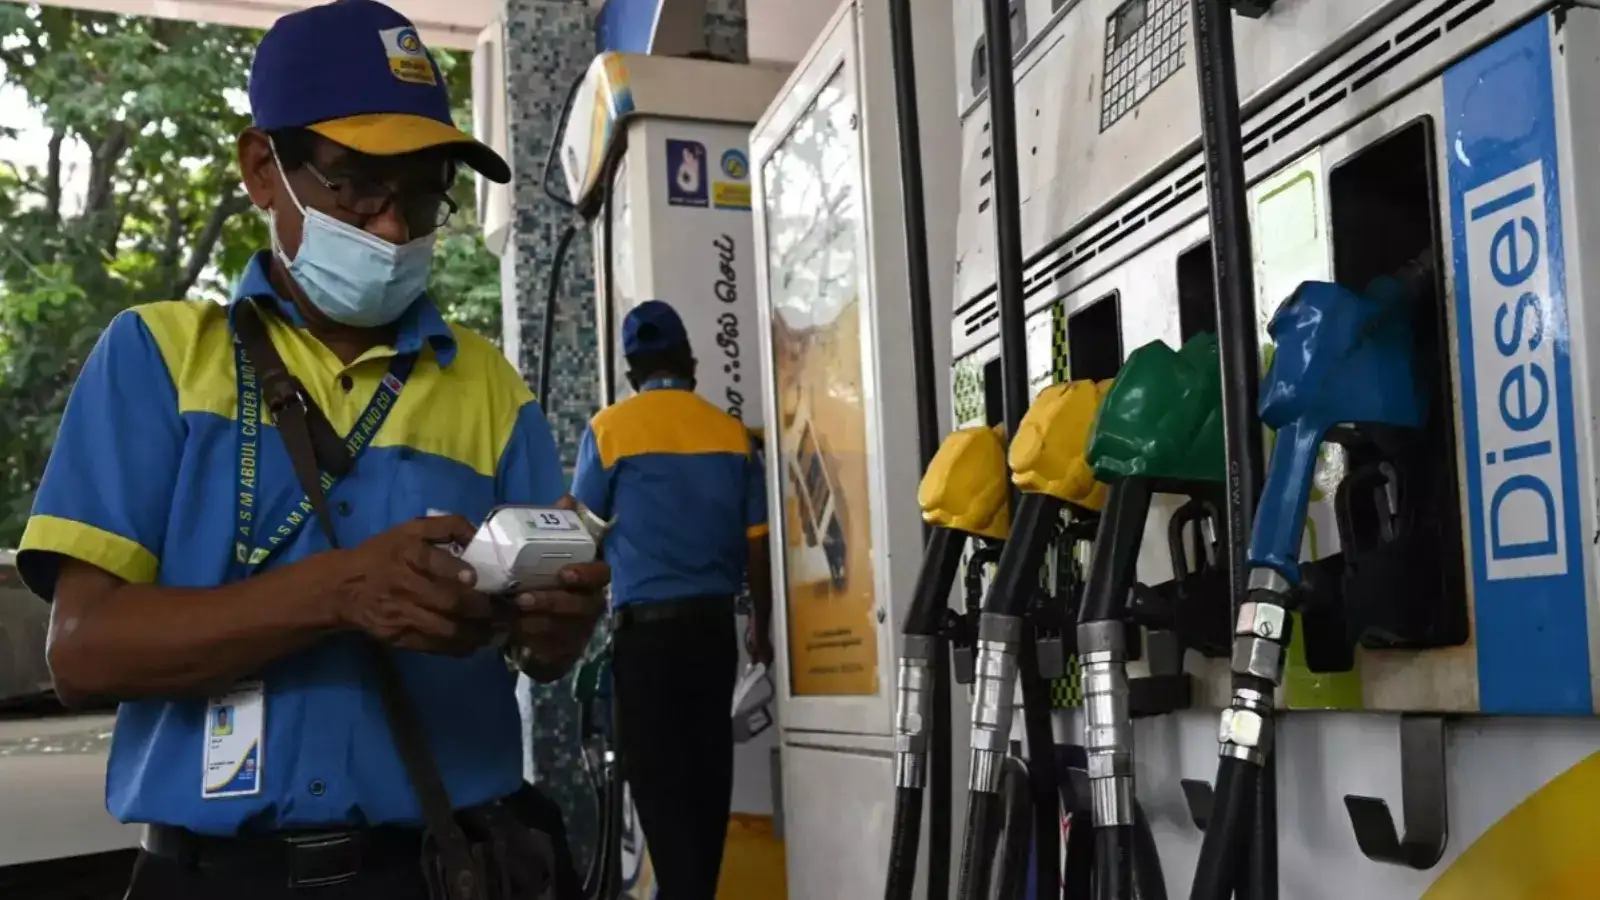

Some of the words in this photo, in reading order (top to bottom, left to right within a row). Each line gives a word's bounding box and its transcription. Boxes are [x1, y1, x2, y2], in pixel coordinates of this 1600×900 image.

[713, 233, 737, 304] செய்
[240, 365, 257, 390] AND
[1470, 182, 1558, 560] Diesel
[242, 390, 258, 437] CADER
[240, 440, 257, 488] ABDUL
[267, 536, 282, 545] A
[276, 525, 292, 535] S
[286, 510, 305, 526] M
[360, 406, 381, 435] AND
[376, 390, 391, 411] CO
[239, 492, 254, 507] M
[240, 510, 252, 522] S
[240, 526, 251, 537] A
[539, 513, 561, 526] 15
